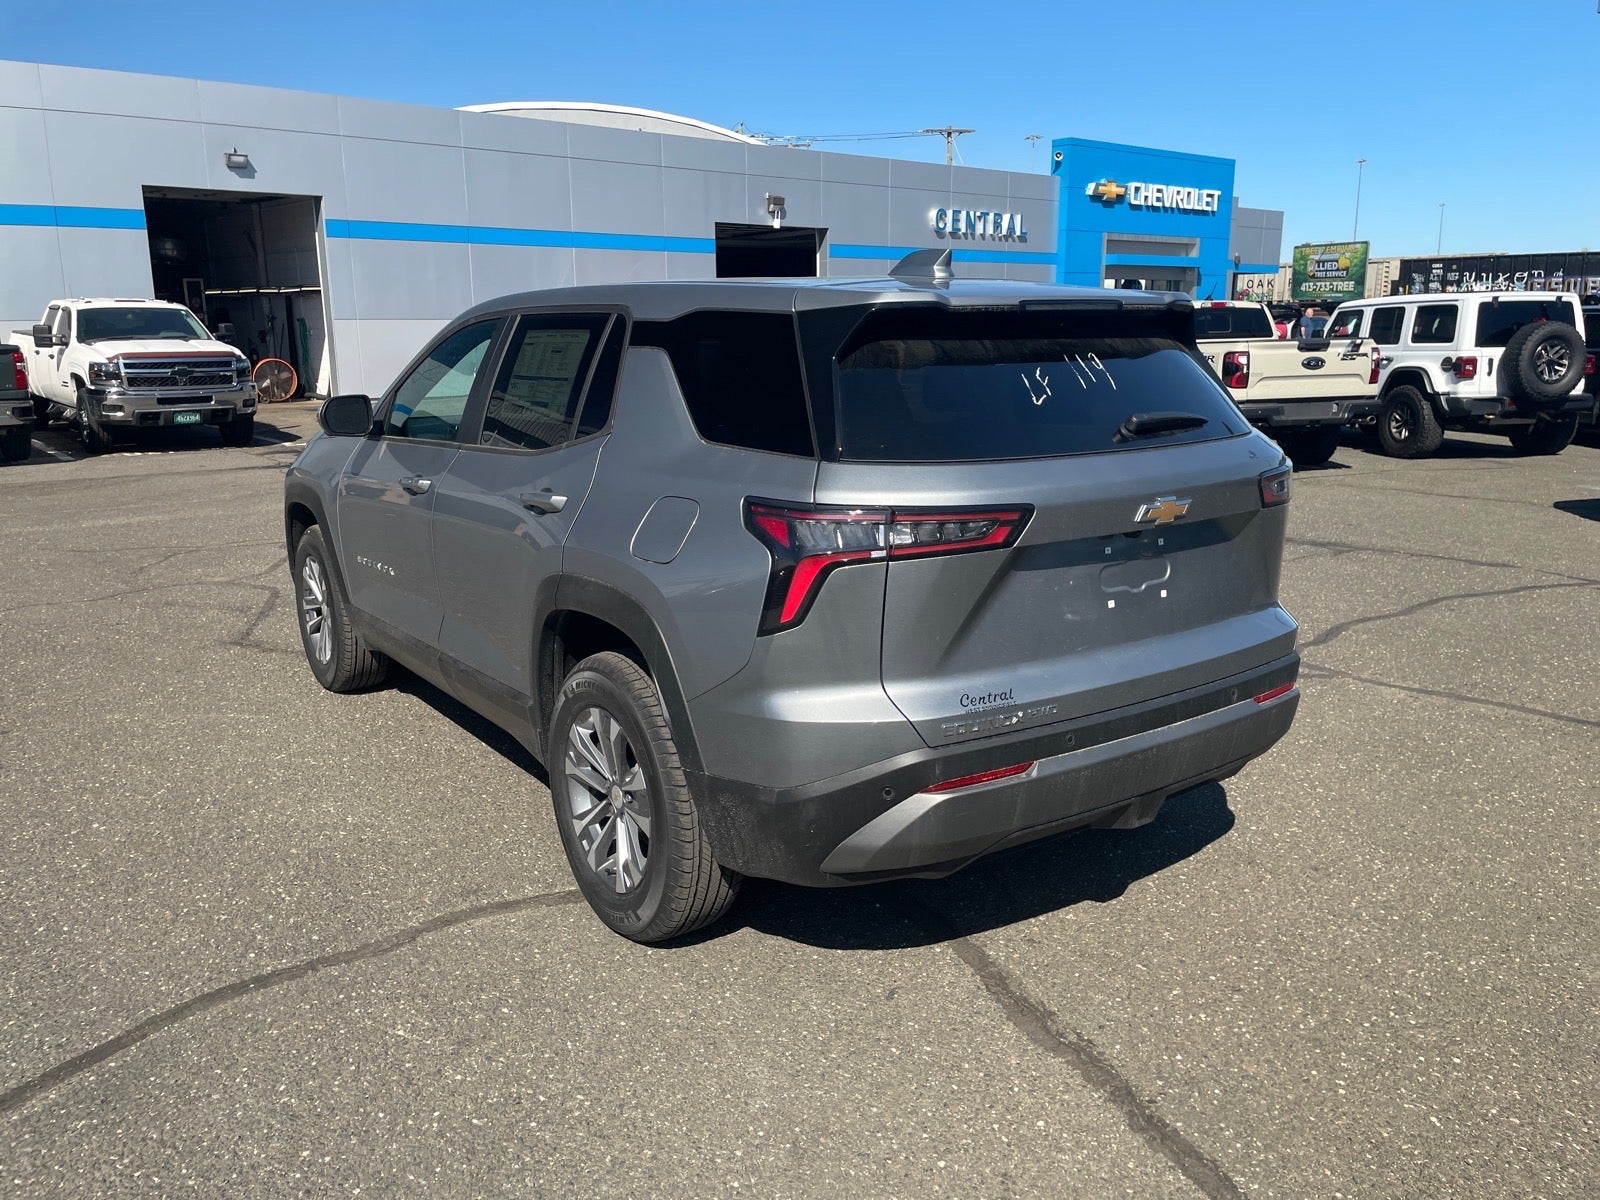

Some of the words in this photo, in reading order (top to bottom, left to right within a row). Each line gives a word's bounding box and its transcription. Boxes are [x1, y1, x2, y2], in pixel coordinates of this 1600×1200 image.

[1129, 182, 1221, 211] CHEVROLET
[935, 208, 1028, 236] CENTRAL
[1327, 270, 1347, 278] SERVICE
[1300, 281, 1355, 292] 413-733-TREE
[960, 688, 1014, 708] Central
